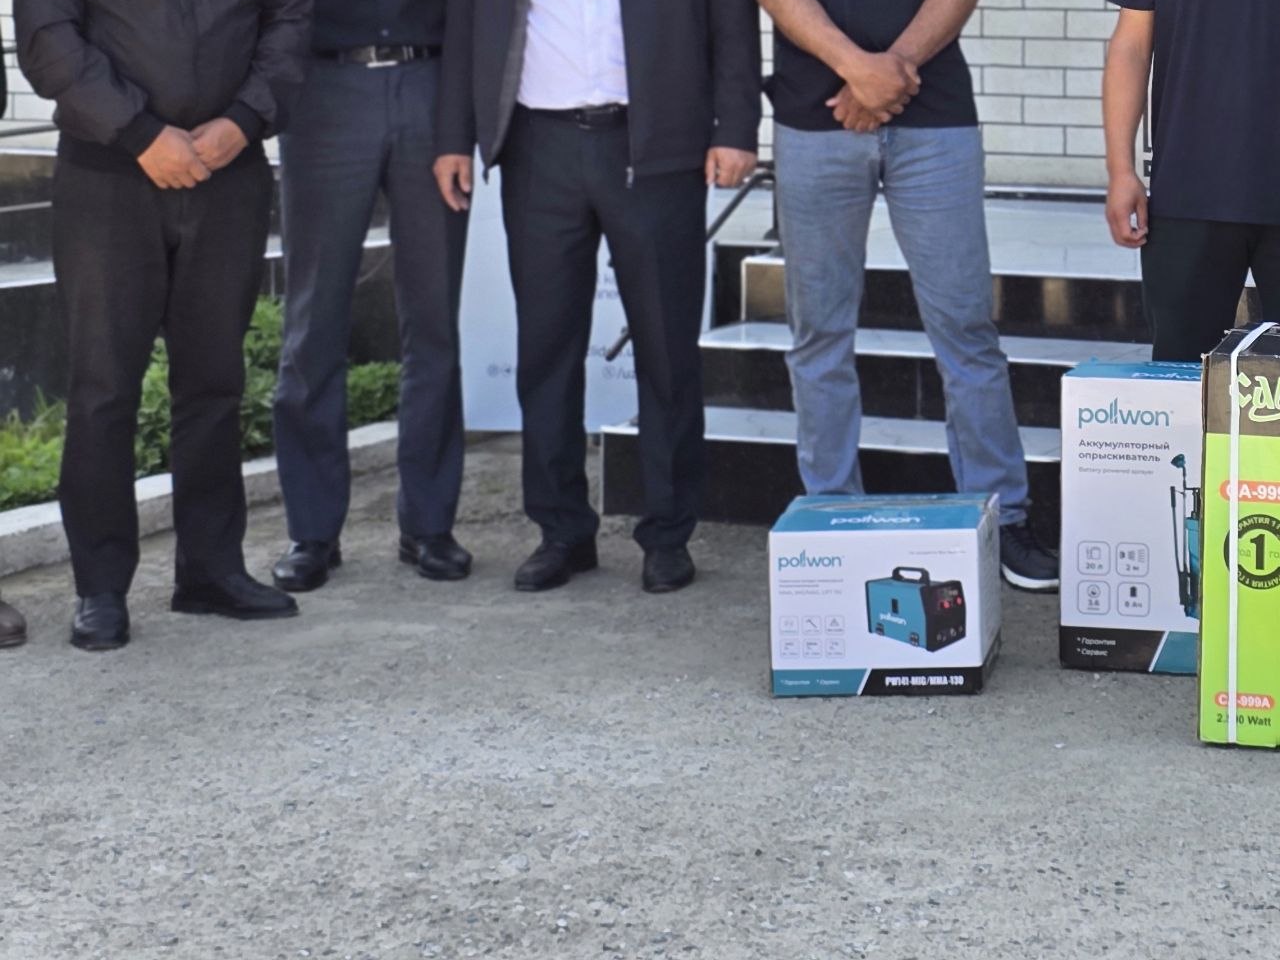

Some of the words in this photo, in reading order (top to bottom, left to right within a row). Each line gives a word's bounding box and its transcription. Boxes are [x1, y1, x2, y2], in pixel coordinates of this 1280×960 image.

[1078, 439, 1170, 451] Аккумуляторный
[1078, 452, 1161, 463] опрыскиватель
[1250, 533, 1266, 571] 1
[1218, 693, 1271, 708] C-999A
[1247, 715, 1272, 727] Watt
